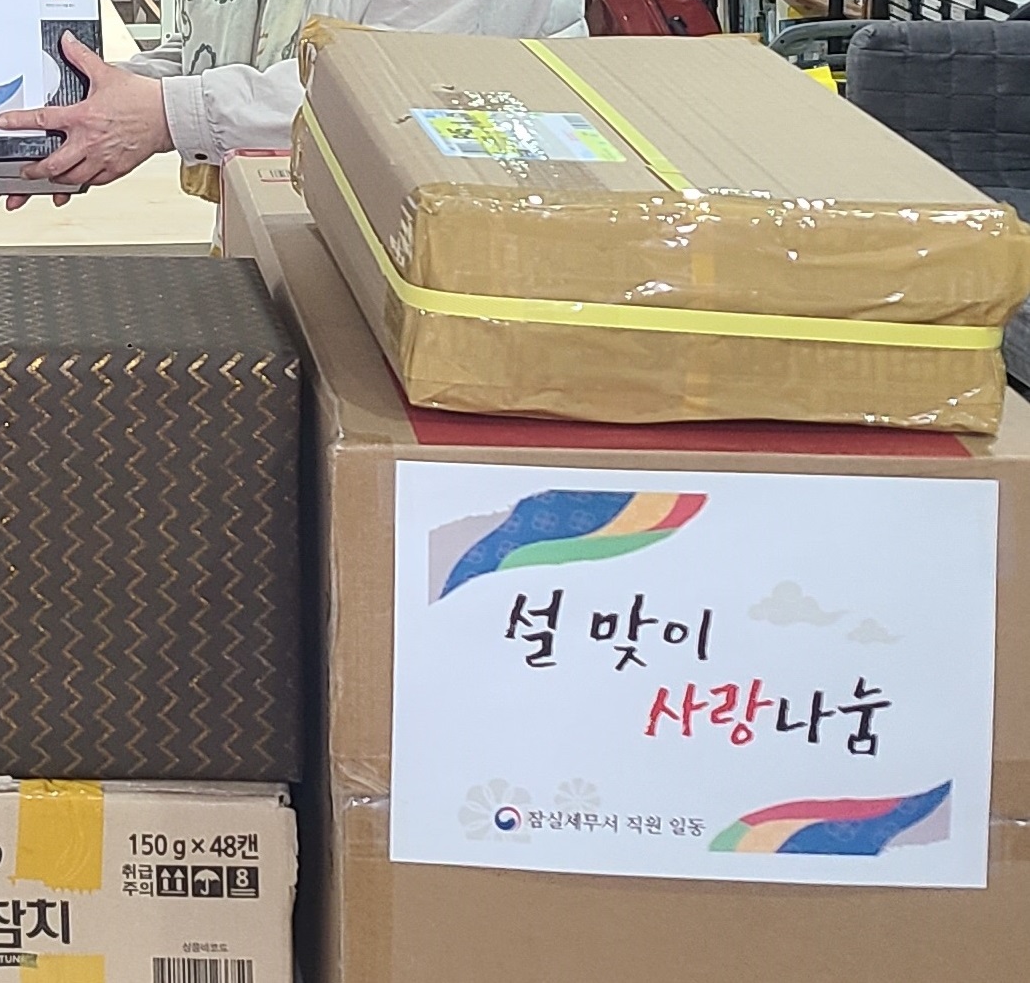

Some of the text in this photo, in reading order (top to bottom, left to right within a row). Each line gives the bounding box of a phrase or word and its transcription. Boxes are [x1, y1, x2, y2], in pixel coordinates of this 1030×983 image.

[505, 589, 713, 672] 설 맞이
[644, 677, 892, 756] 사랑나눔
[527, 809, 707, 838] 잠실세무서 직원 일동
[129, 834, 168, 856] 150
[209, 833, 259, 860] 48캔
[122, 864, 153, 879] 취급
[122, 881, 154, 897] 주의
